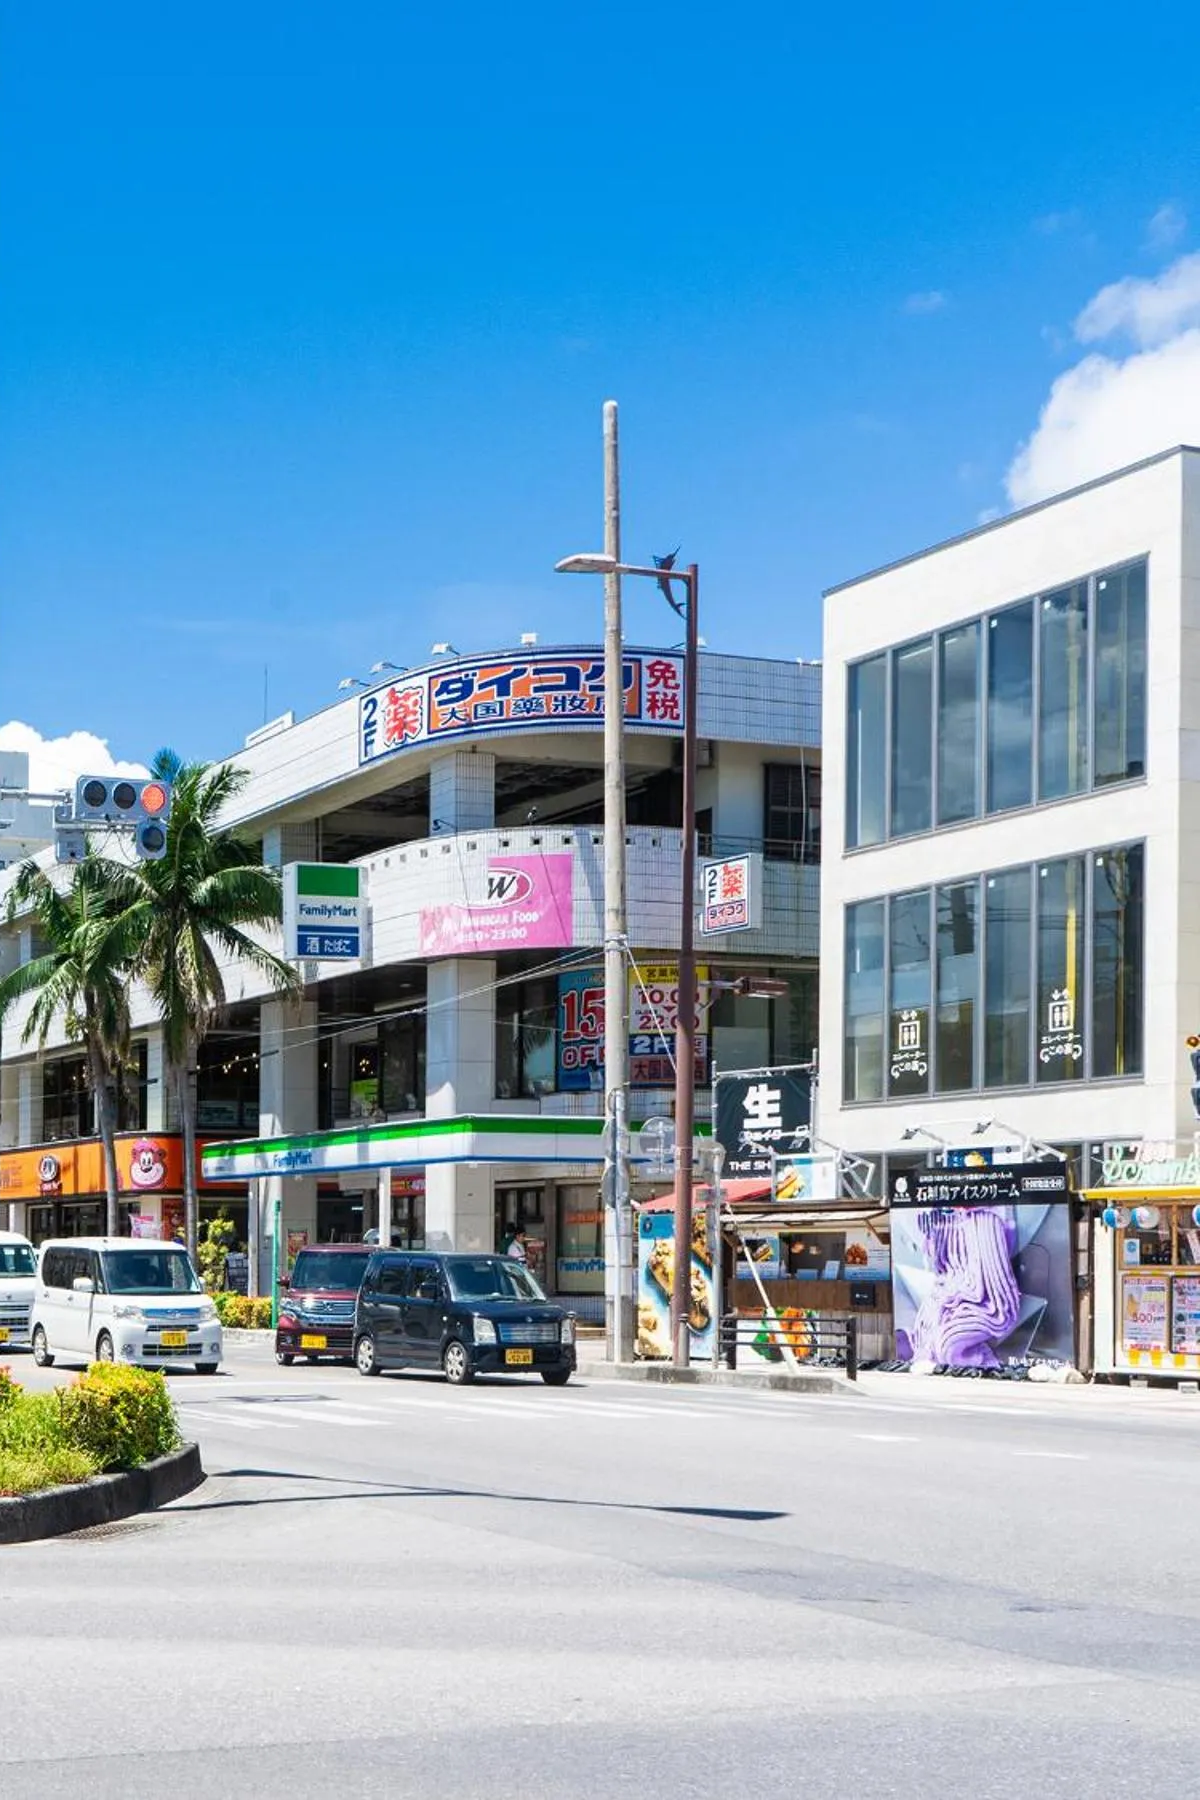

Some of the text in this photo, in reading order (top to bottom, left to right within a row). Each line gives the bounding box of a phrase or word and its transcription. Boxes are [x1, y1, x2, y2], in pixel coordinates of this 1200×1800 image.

[646, 659, 681, 721] 免税
[362, 697, 379, 756] 2F
[382, 687, 424, 746] 薬
[708, 868, 718, 904] 2F
[299, 903, 357, 918] FamilyMart
[709, 903, 743, 919] ダイコク
[306, 937, 352, 953] 酒 たばこ
[742, 1083, 783, 1129] 生
[273, 1150, 313, 1168] FamilyMart
[729, 1161, 751, 1171] THE
[916, 1183, 1020, 1203] 石垣島アイスクリーム
